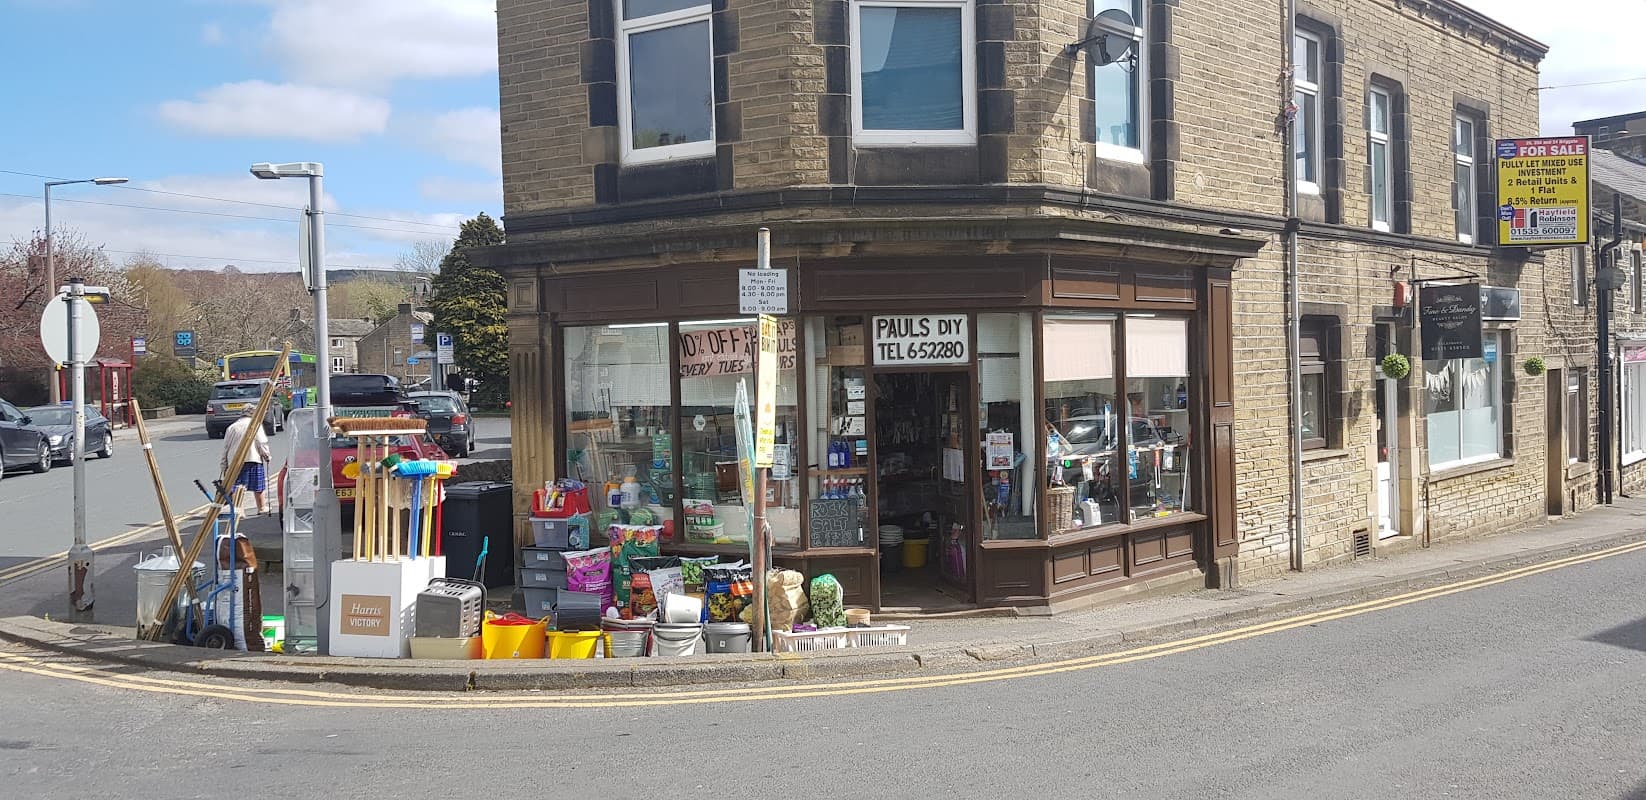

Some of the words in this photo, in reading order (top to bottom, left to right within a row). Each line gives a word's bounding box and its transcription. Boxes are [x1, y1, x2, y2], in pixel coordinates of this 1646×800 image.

[1520, 146, 1547, 157] FOR
[1550, 144, 1584, 155] SALE
[1501, 160, 1524, 169] FULLY
[1526, 160, 1539, 168] LET
[1542, 159, 1566, 167] MIXED
[1568, 158, 1583, 166] USE
[1518, 168, 1567, 177] INVESTMENT
[1516, 178, 1542, 186] Retail
[1545, 177, 1568, 185] Units
[1570, 176, 1577, 184] &
[1538, 186, 1556, 194] Flat
[1530, 197, 1558, 205] Return
[1539, 208, 1576, 217] Hayfield
[1441, 306, 1449, 314] &
[876, 317, 930, 339] PAULS
[938, 318, 963, 336] DIY
[441, 336, 449, 345] P
[680, 333, 705, 358] 10%
[707, 328, 740, 355] OFF
[877, 342, 904, 360] TEL
[907, 340, 964, 359] 652280
[680, 361, 713, 377] EVERY
[718, 359, 745, 374] TUES
[810, 500, 849, 519] ROCK
[810, 517, 849, 533] SALT
[351, 602, 382, 615] Harris
[350, 617, 382, 628] VICTORY
